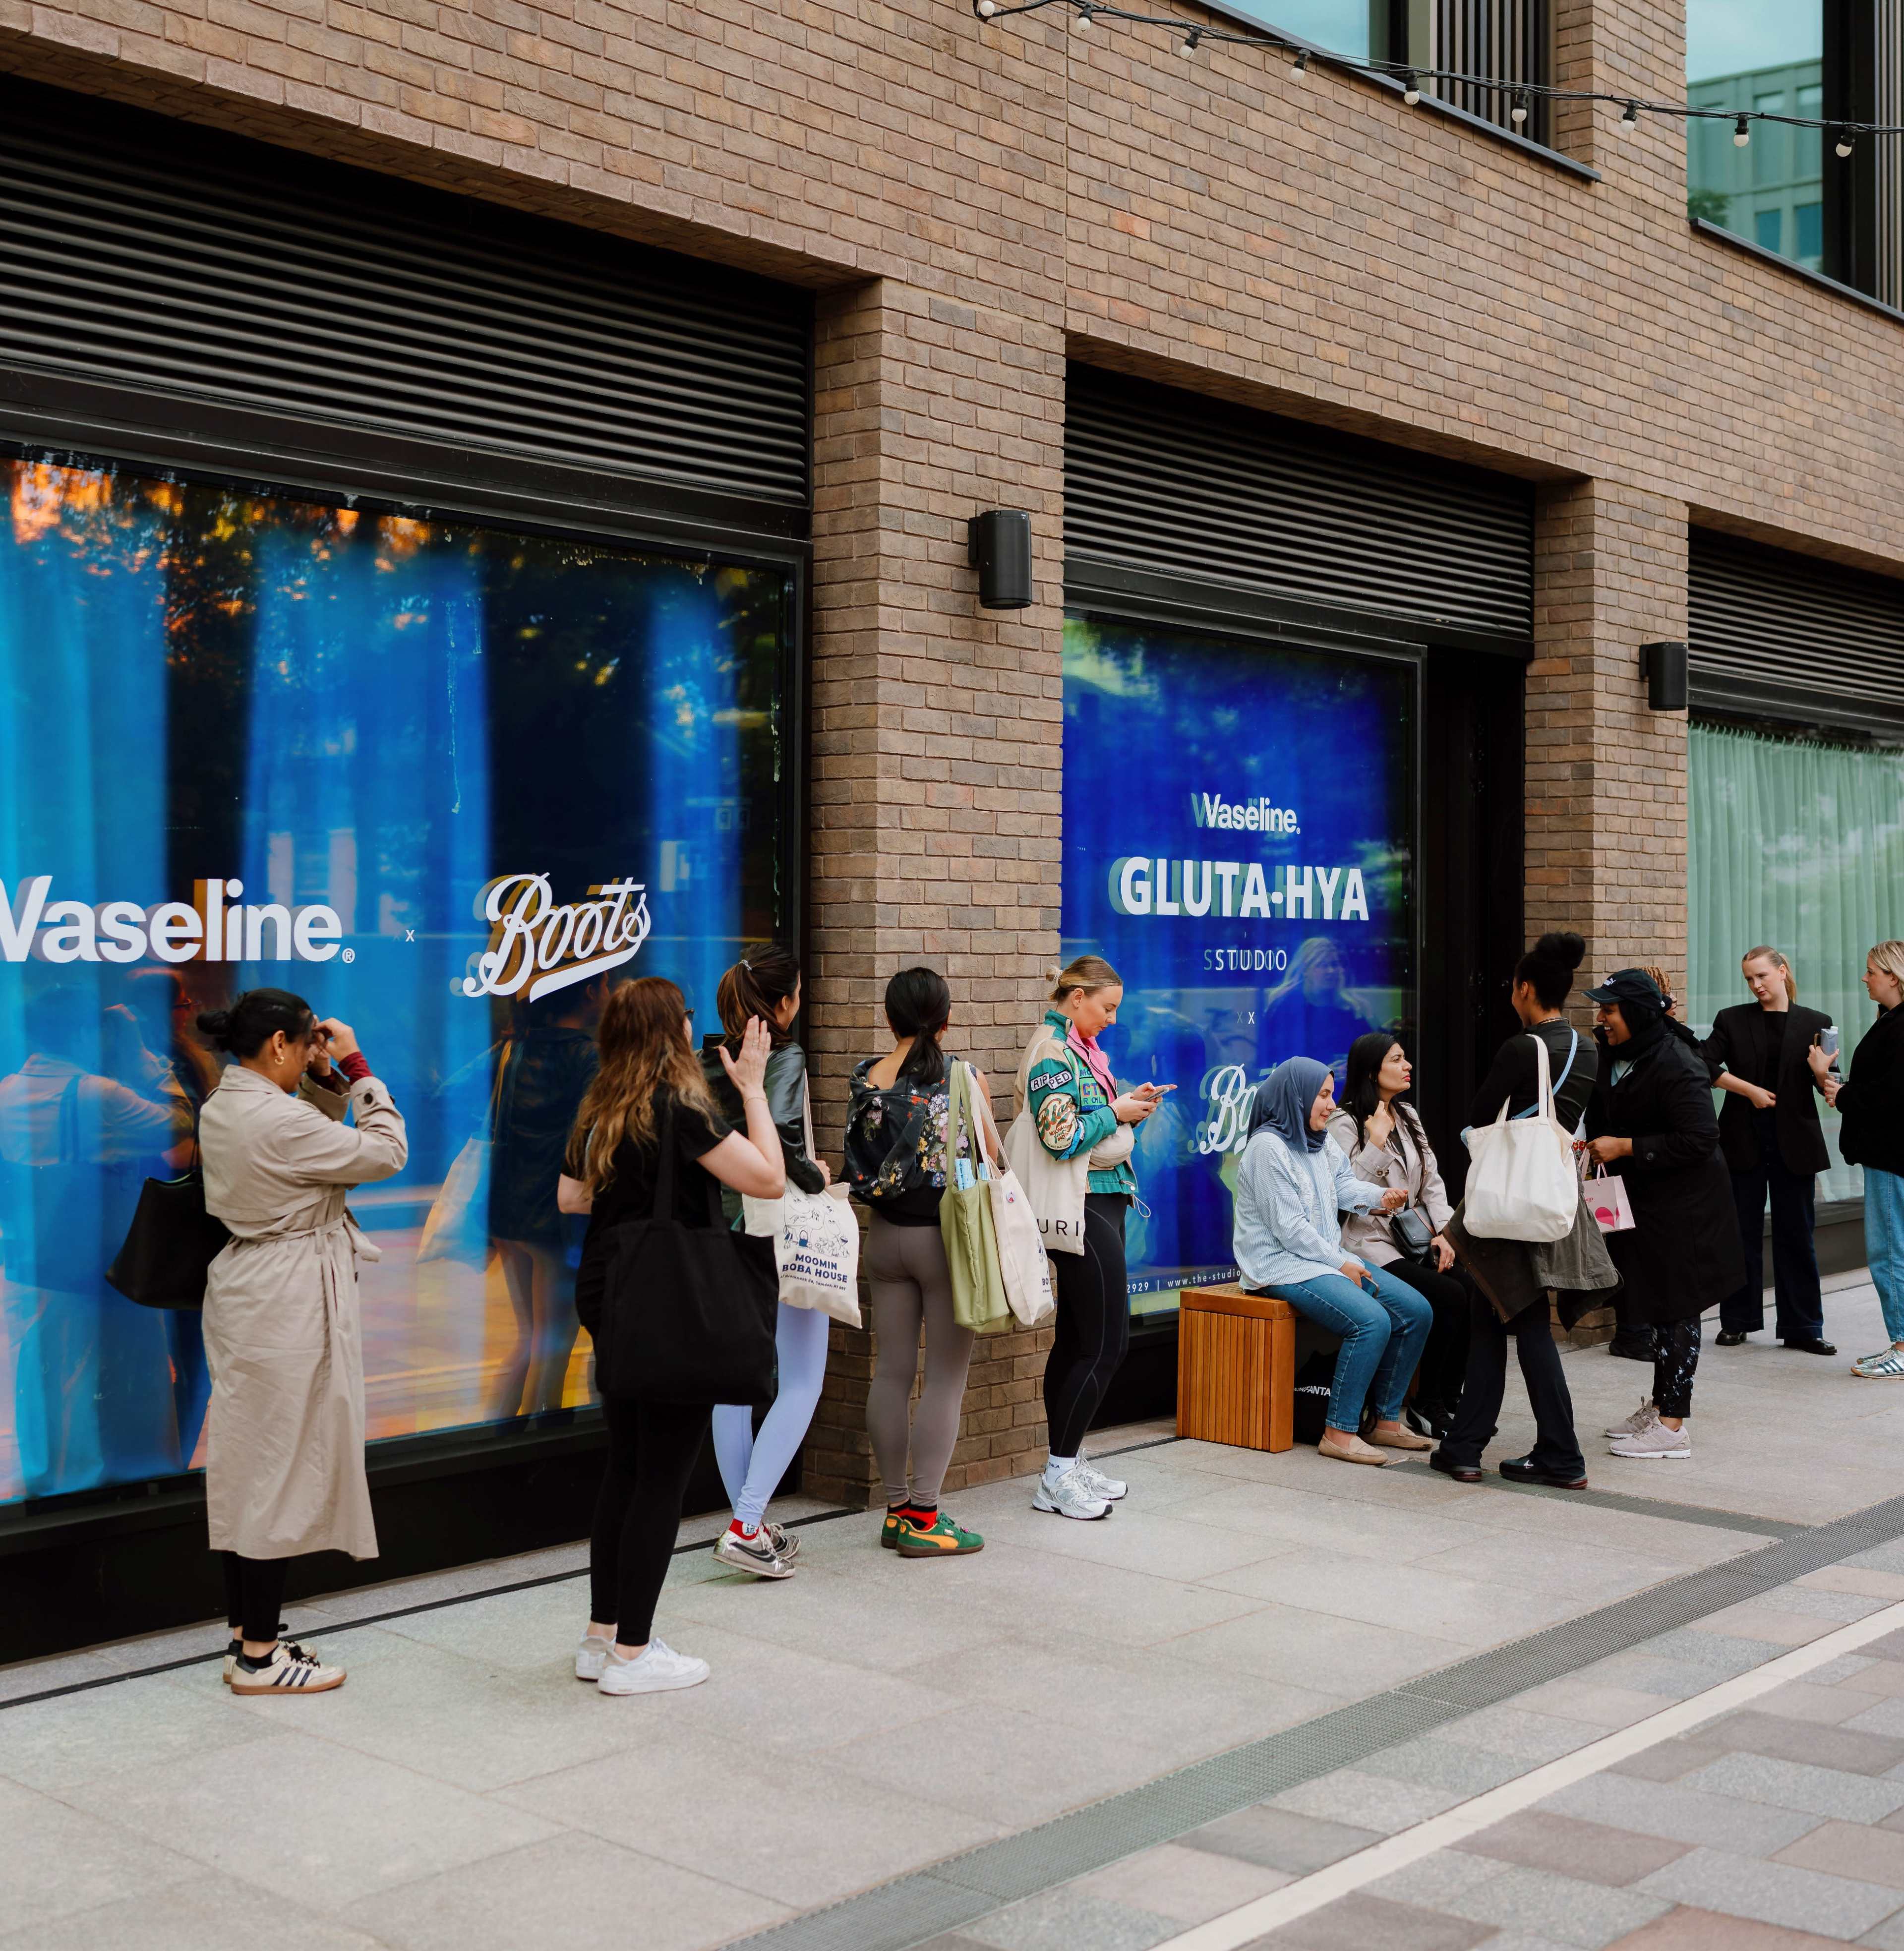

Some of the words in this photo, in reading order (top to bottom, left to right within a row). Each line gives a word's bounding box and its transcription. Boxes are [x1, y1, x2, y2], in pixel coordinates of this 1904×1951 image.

[463, 872, 651, 1003] Boots
[1215, 948, 1287, 971] STUDIO
[1037, 1219, 1079, 1236] URI
[795, 1253, 837, 1270] MOOMIN
[782, 1263, 811, 1275] BOBA
[815, 1268, 848, 1283] HOUSE
[1168, 1268, 1241, 1288] www.the-studio
